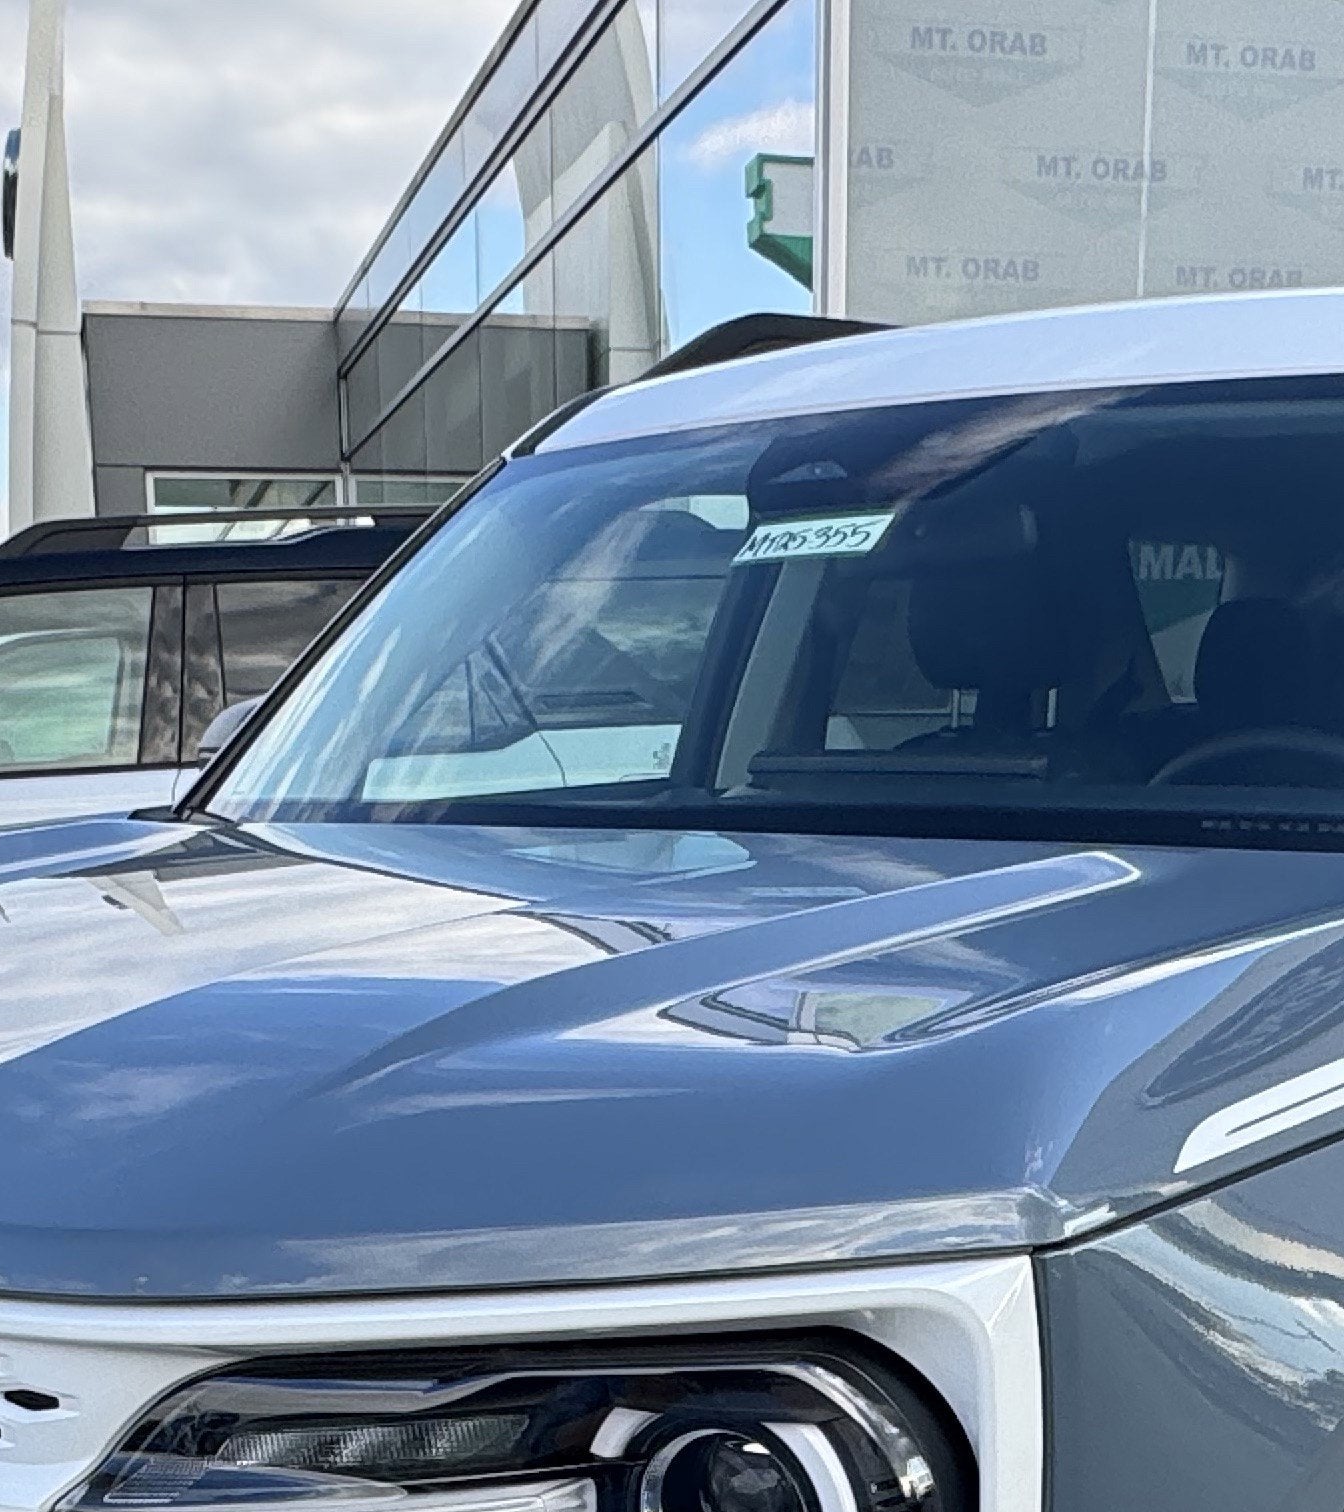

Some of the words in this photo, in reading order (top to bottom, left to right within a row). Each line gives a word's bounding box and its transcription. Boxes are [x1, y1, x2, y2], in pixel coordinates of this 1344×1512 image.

[910, 26, 956, 51] MT.
[967, 28, 1048, 56] ORAB
[1240, 45, 1316, 71] ORAB
[961, 256, 1040, 281] ORAB
